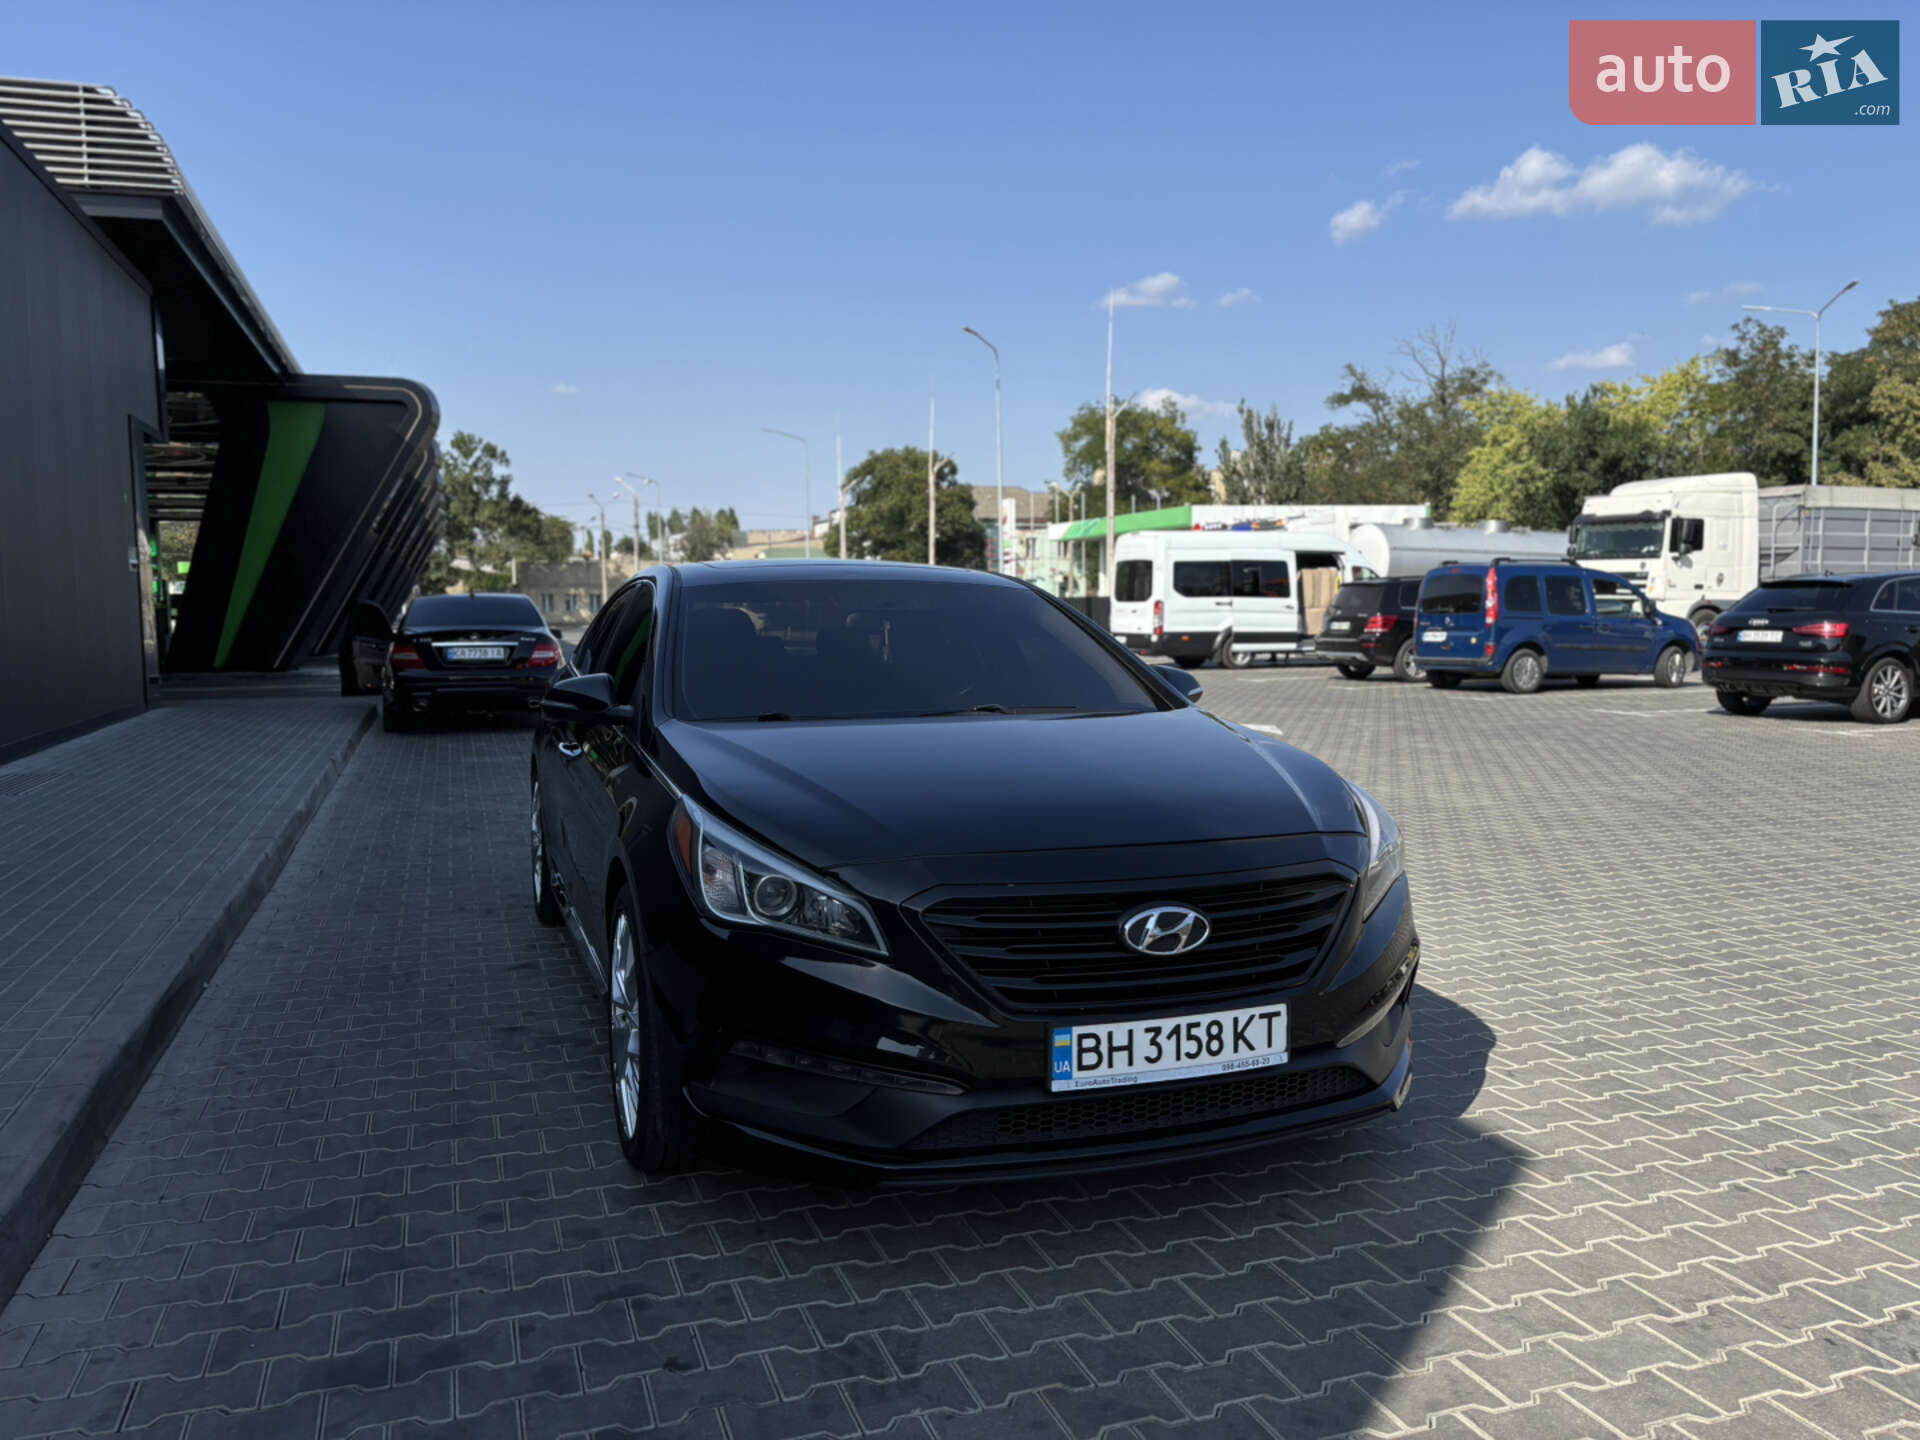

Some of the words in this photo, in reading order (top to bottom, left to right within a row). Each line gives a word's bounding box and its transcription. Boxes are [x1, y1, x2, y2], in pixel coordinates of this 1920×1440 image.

[1077, 1029, 1134, 1072] BH
[1144, 1018, 1224, 1064] 3158
[1233, 1011, 1282, 1054] KT
[1055, 1061, 1071, 1073] UA
